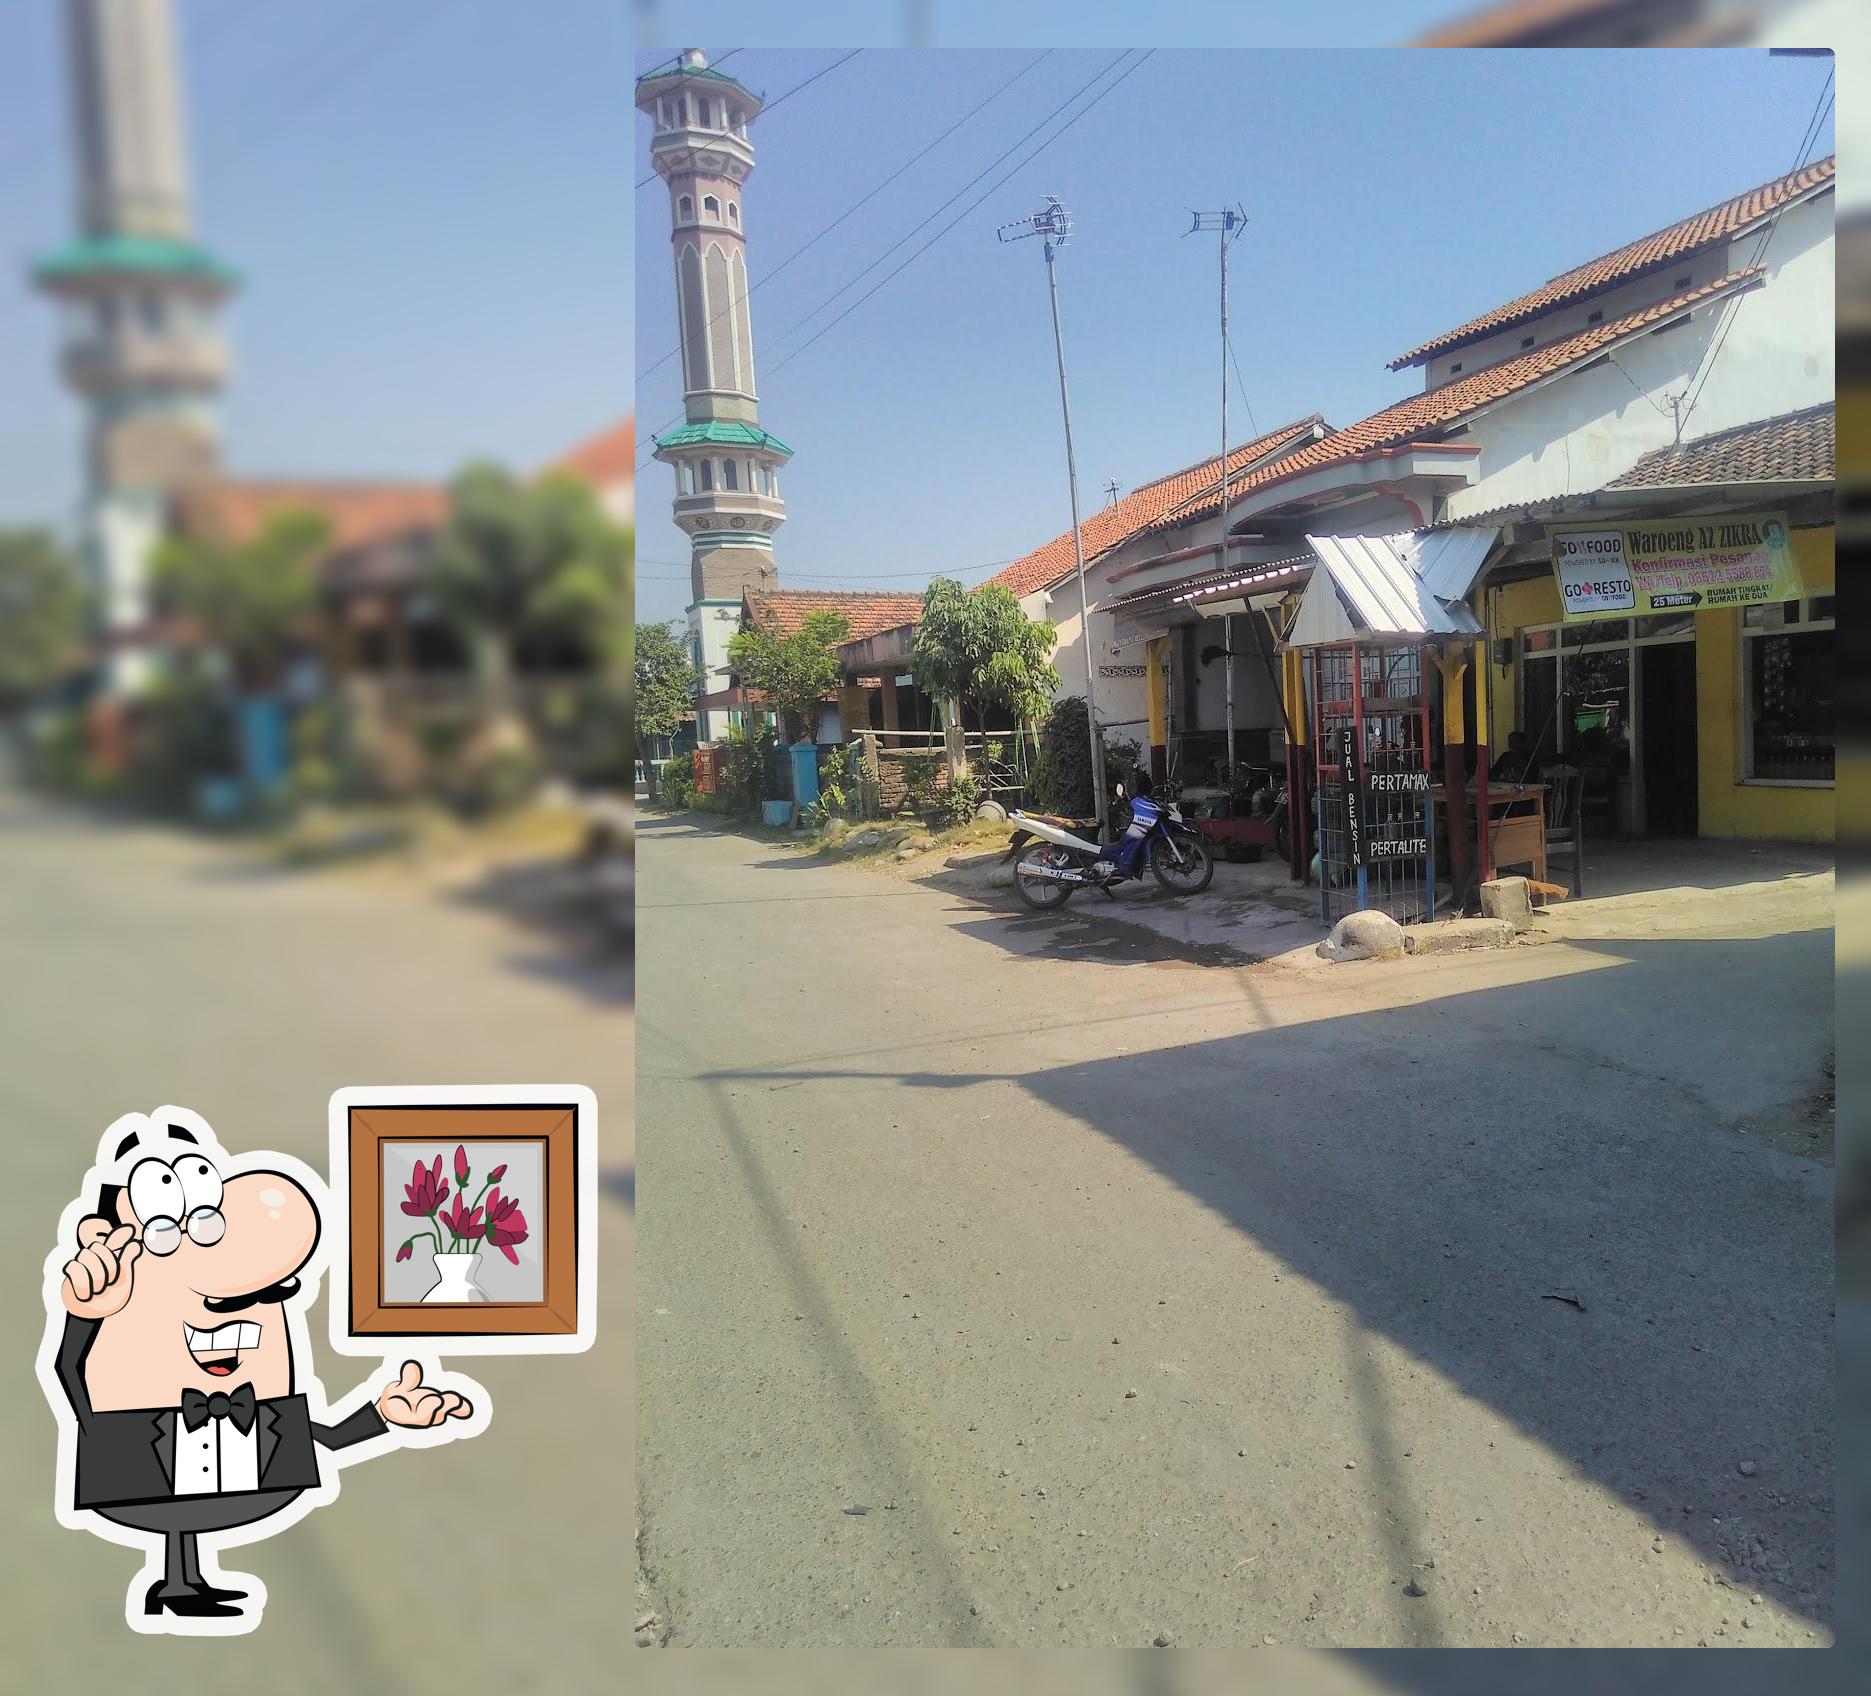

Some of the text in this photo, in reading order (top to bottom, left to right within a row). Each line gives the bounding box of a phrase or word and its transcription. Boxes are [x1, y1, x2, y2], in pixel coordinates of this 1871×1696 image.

[1587, 539, 1621, 554] FOOD
[1627, 529, 1694, 554] Waroeng
[1719, 523, 1763, 547] ZIKRA
[1564, 580, 1631, 597] GO RESTO
[1707, 587, 1736, 597] RUMAH
[1653, 594, 1693, 607] 25 Meter
[1708, 592, 1768, 604] RUMAH KE DUA
[1344, 731, 1355, 782] JUAL
[1371, 773, 1429, 791] PERTAMAX
[1348, 793, 1361, 865] BENSIN
[1370, 838, 1427, 857] PERTALITE
